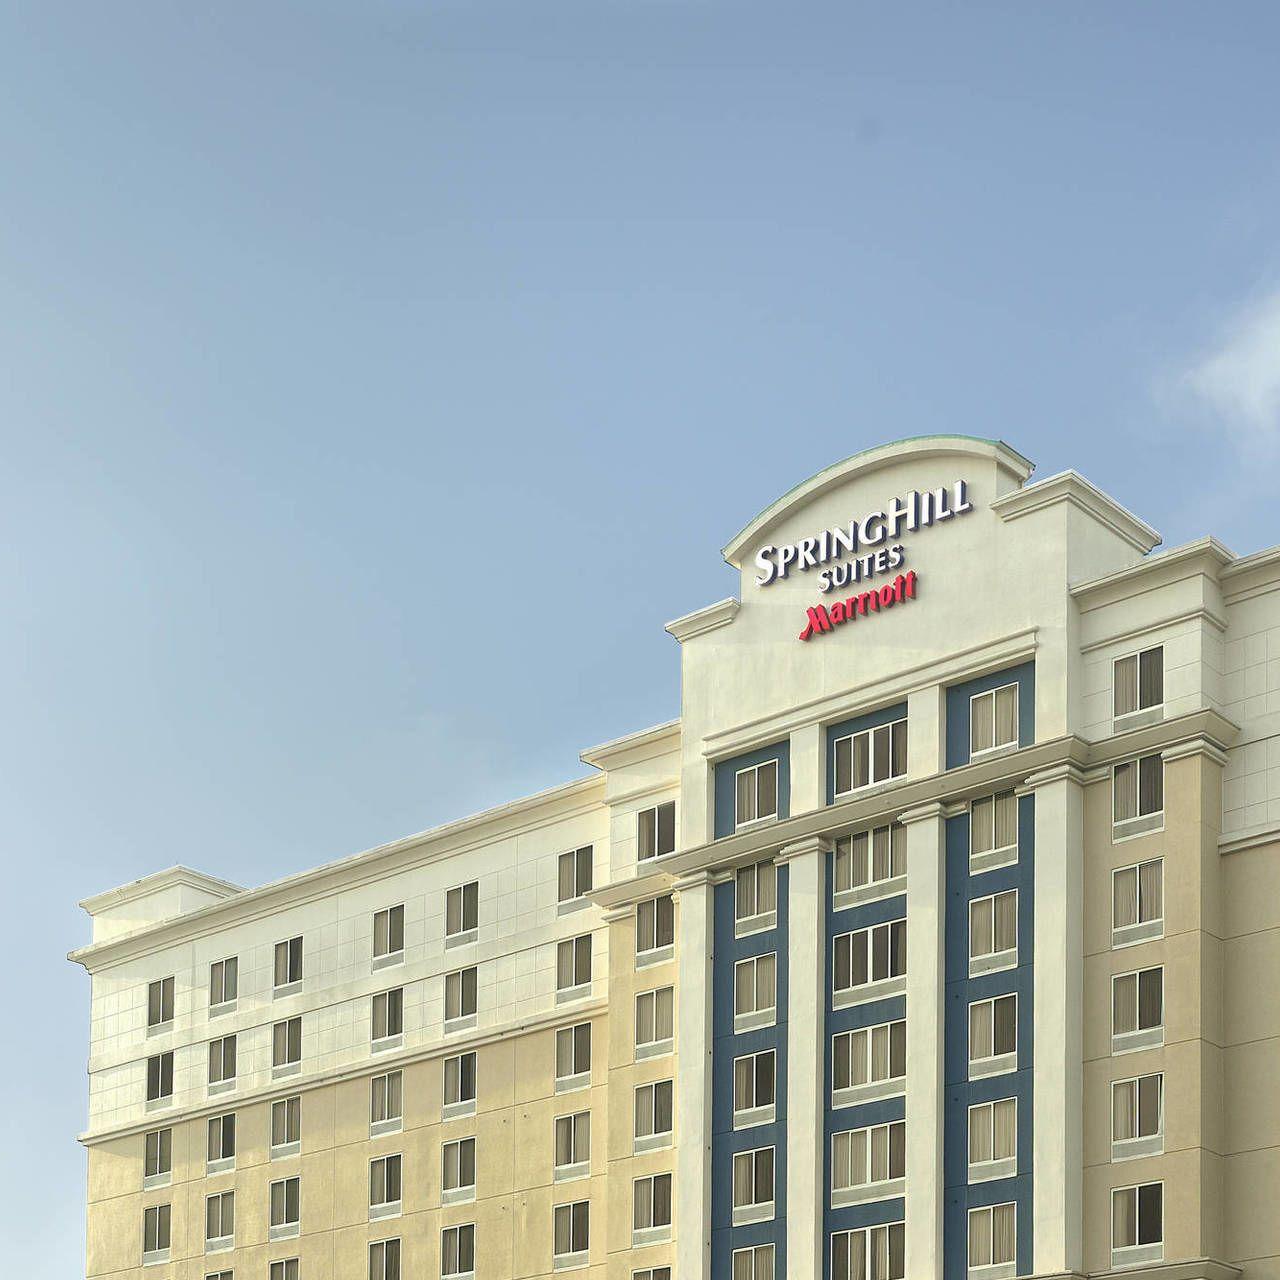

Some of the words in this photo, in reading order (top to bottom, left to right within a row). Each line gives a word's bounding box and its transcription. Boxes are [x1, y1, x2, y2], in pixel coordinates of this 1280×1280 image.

[754, 479, 973, 587] SPRINGHILL
[817, 544, 905, 593] SUITES
[799, 569, 919, 641] Marriott
